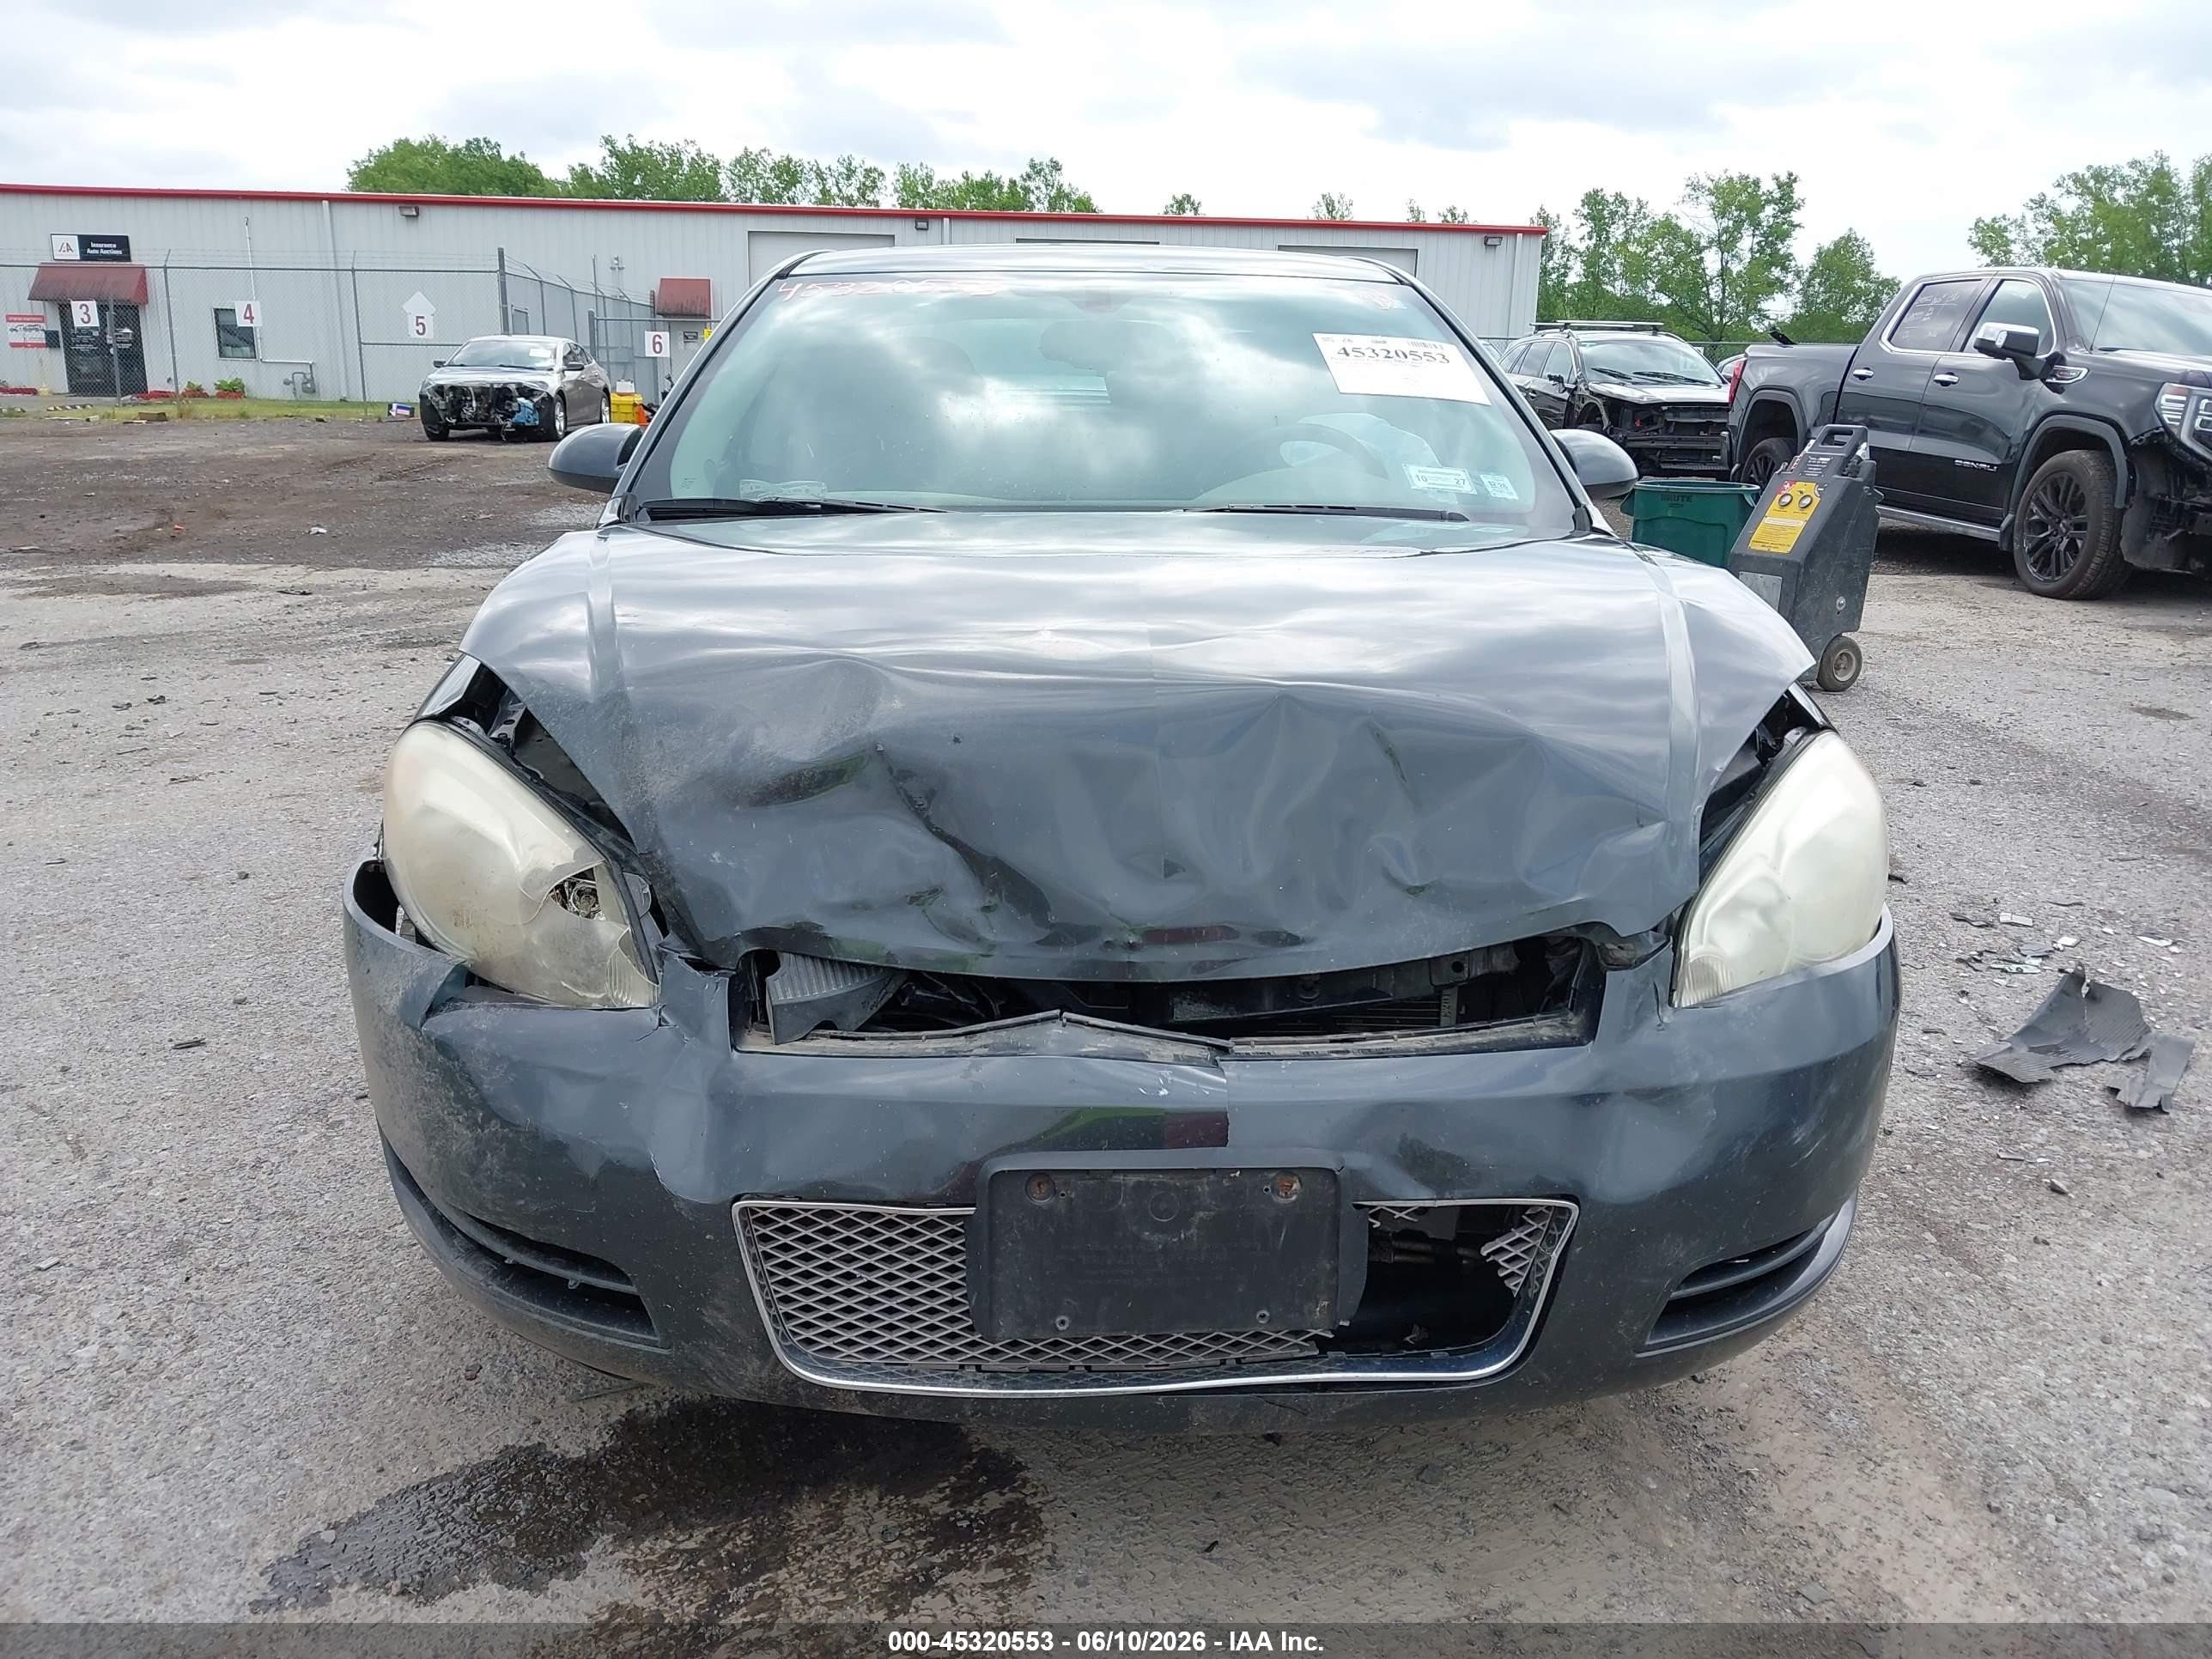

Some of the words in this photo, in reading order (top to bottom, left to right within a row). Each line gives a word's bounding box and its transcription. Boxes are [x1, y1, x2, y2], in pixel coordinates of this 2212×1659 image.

[79, 303, 92, 325] 3
[243, 303, 255, 325] 4
[415, 315, 427, 336] 5
[652, 334, 663, 355] 6
[1337, 346, 1450, 364] 45320553
[1954, 459, 1998, 471] DENALI
[1415, 473, 1428, 483] 10
[1454, 477, 1466, 486] 27
